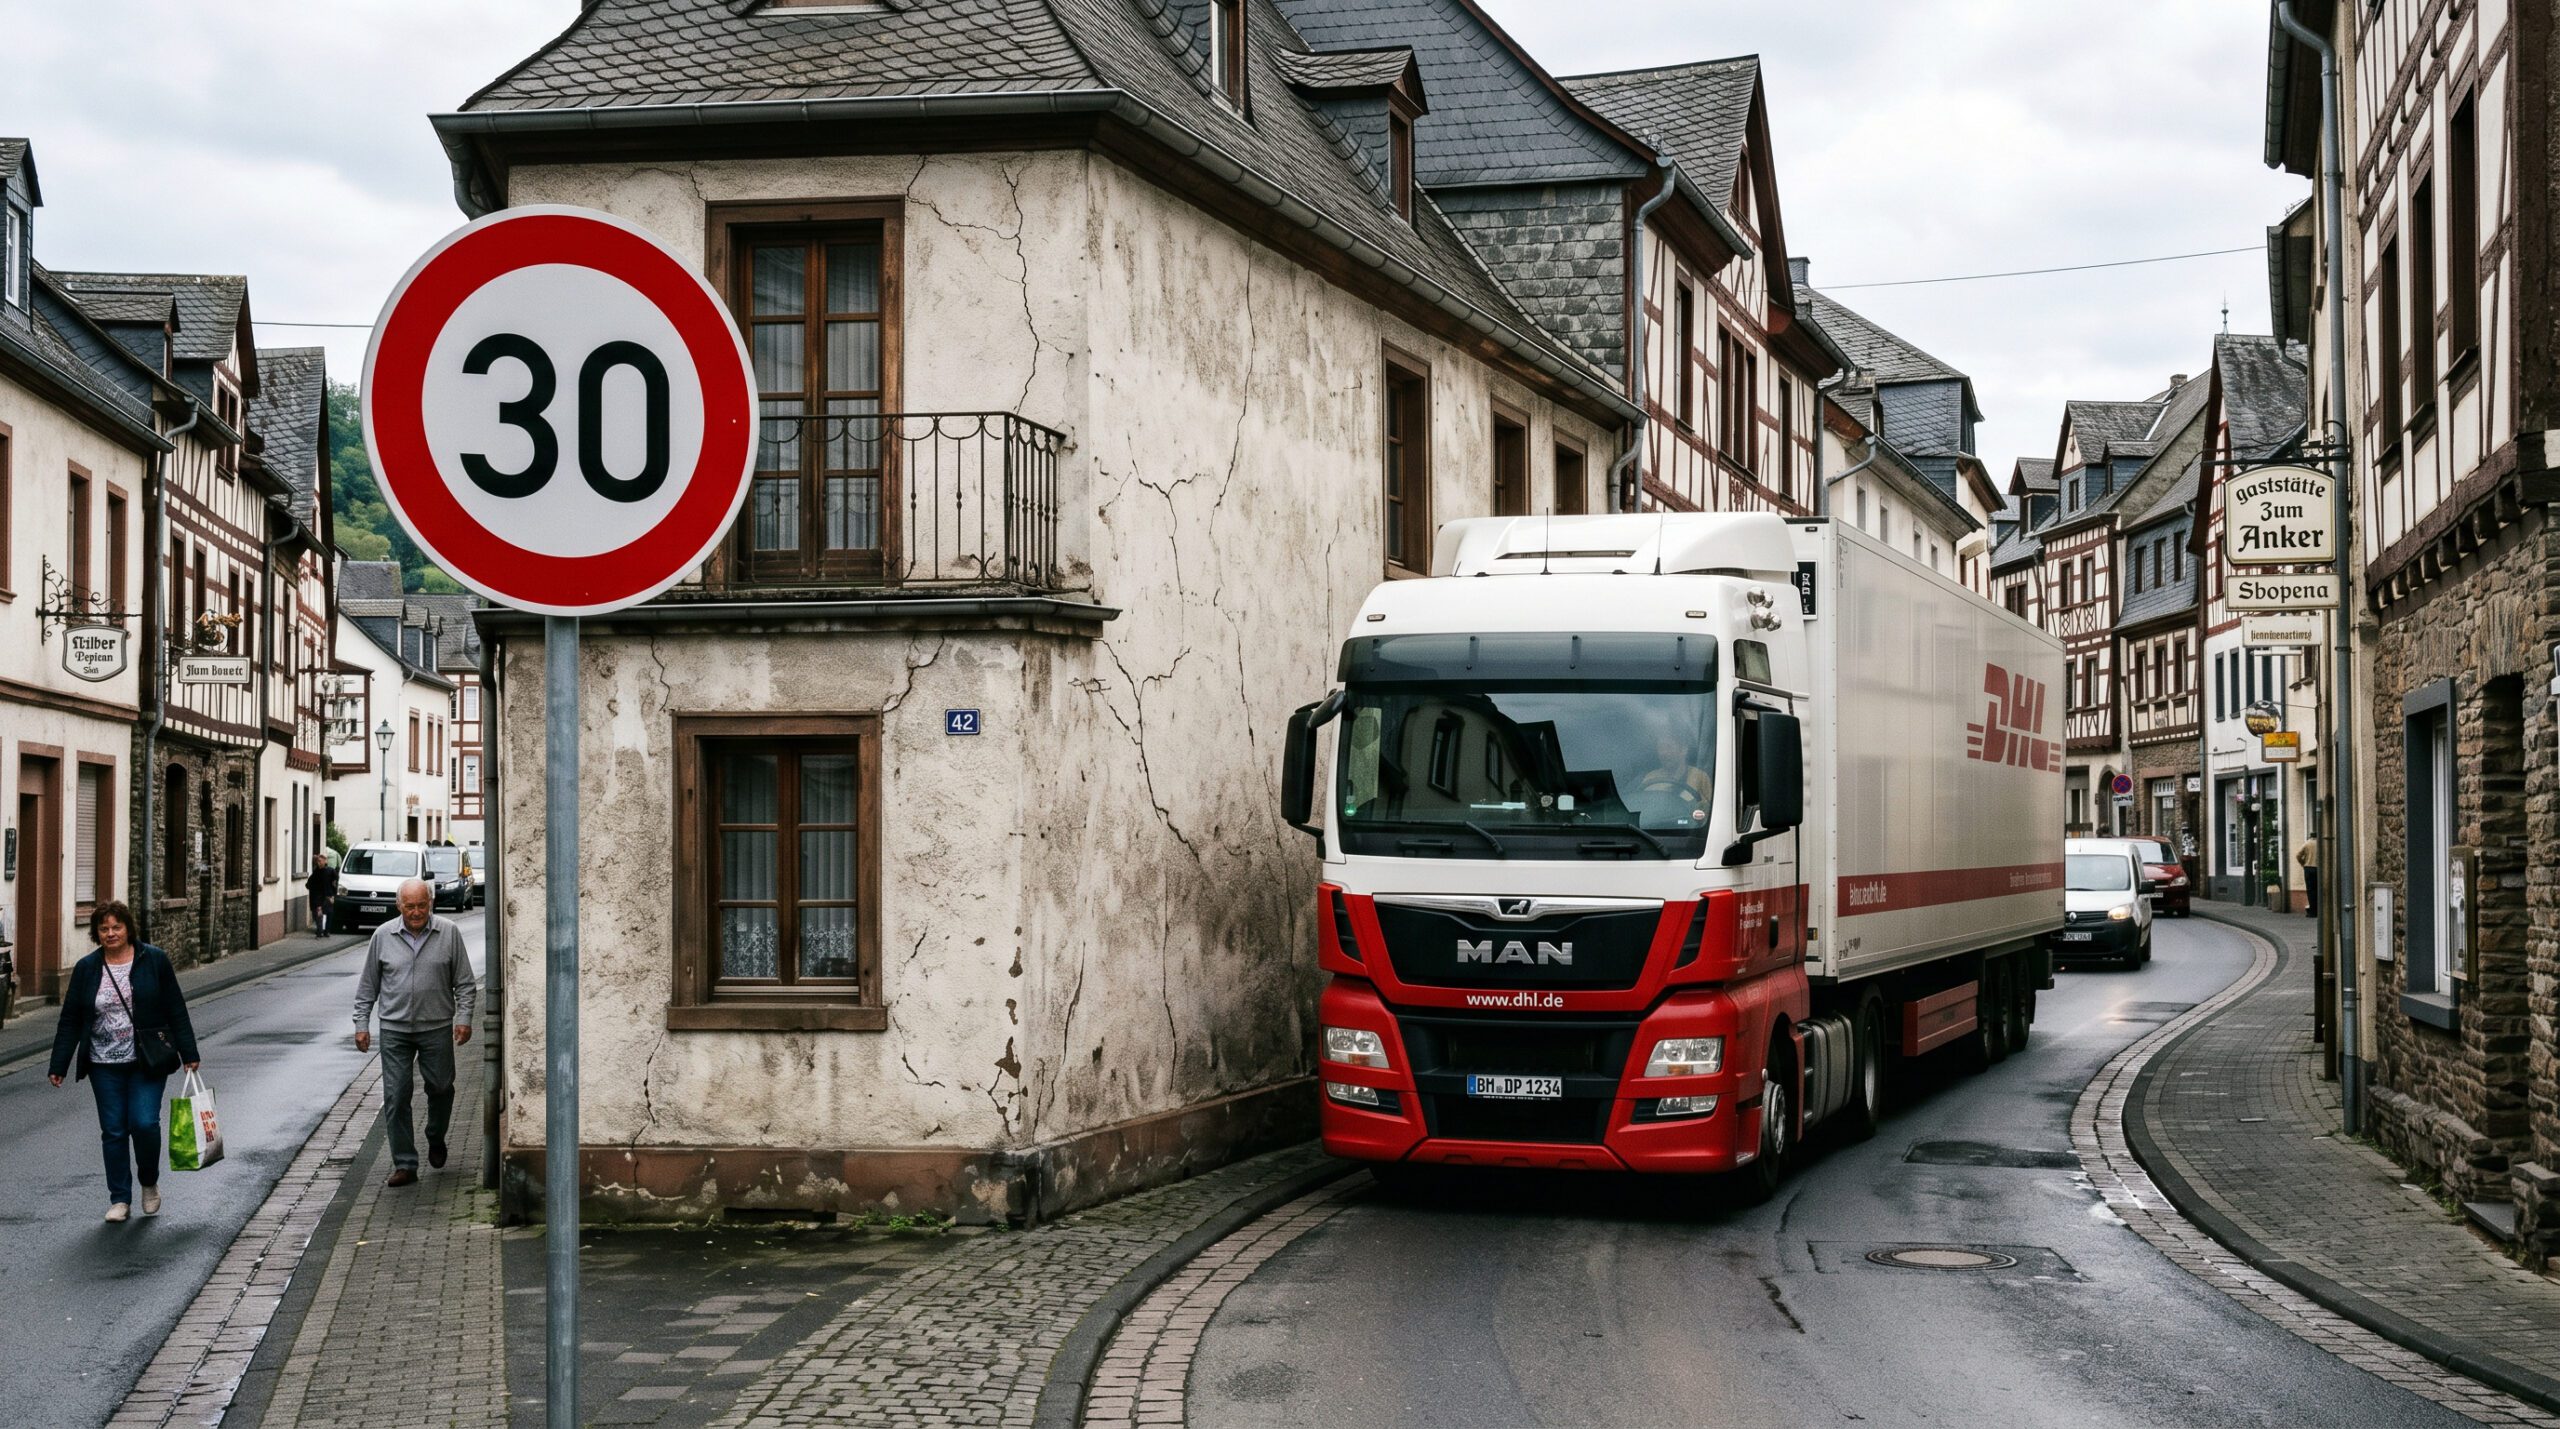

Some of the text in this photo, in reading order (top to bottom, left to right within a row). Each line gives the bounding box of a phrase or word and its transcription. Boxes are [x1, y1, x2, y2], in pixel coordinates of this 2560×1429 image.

[459, 332, 671, 504] 30
[2237, 524, 2324, 553] Anker
[951, 713, 974, 731] 42
[1983, 662, 2049, 772] DHL
[1457, 939, 1573, 966] MAN
[1466, 992, 1564, 1008] www.dhl.de
[1477, 1077, 1561, 1096] BM DP 1234
